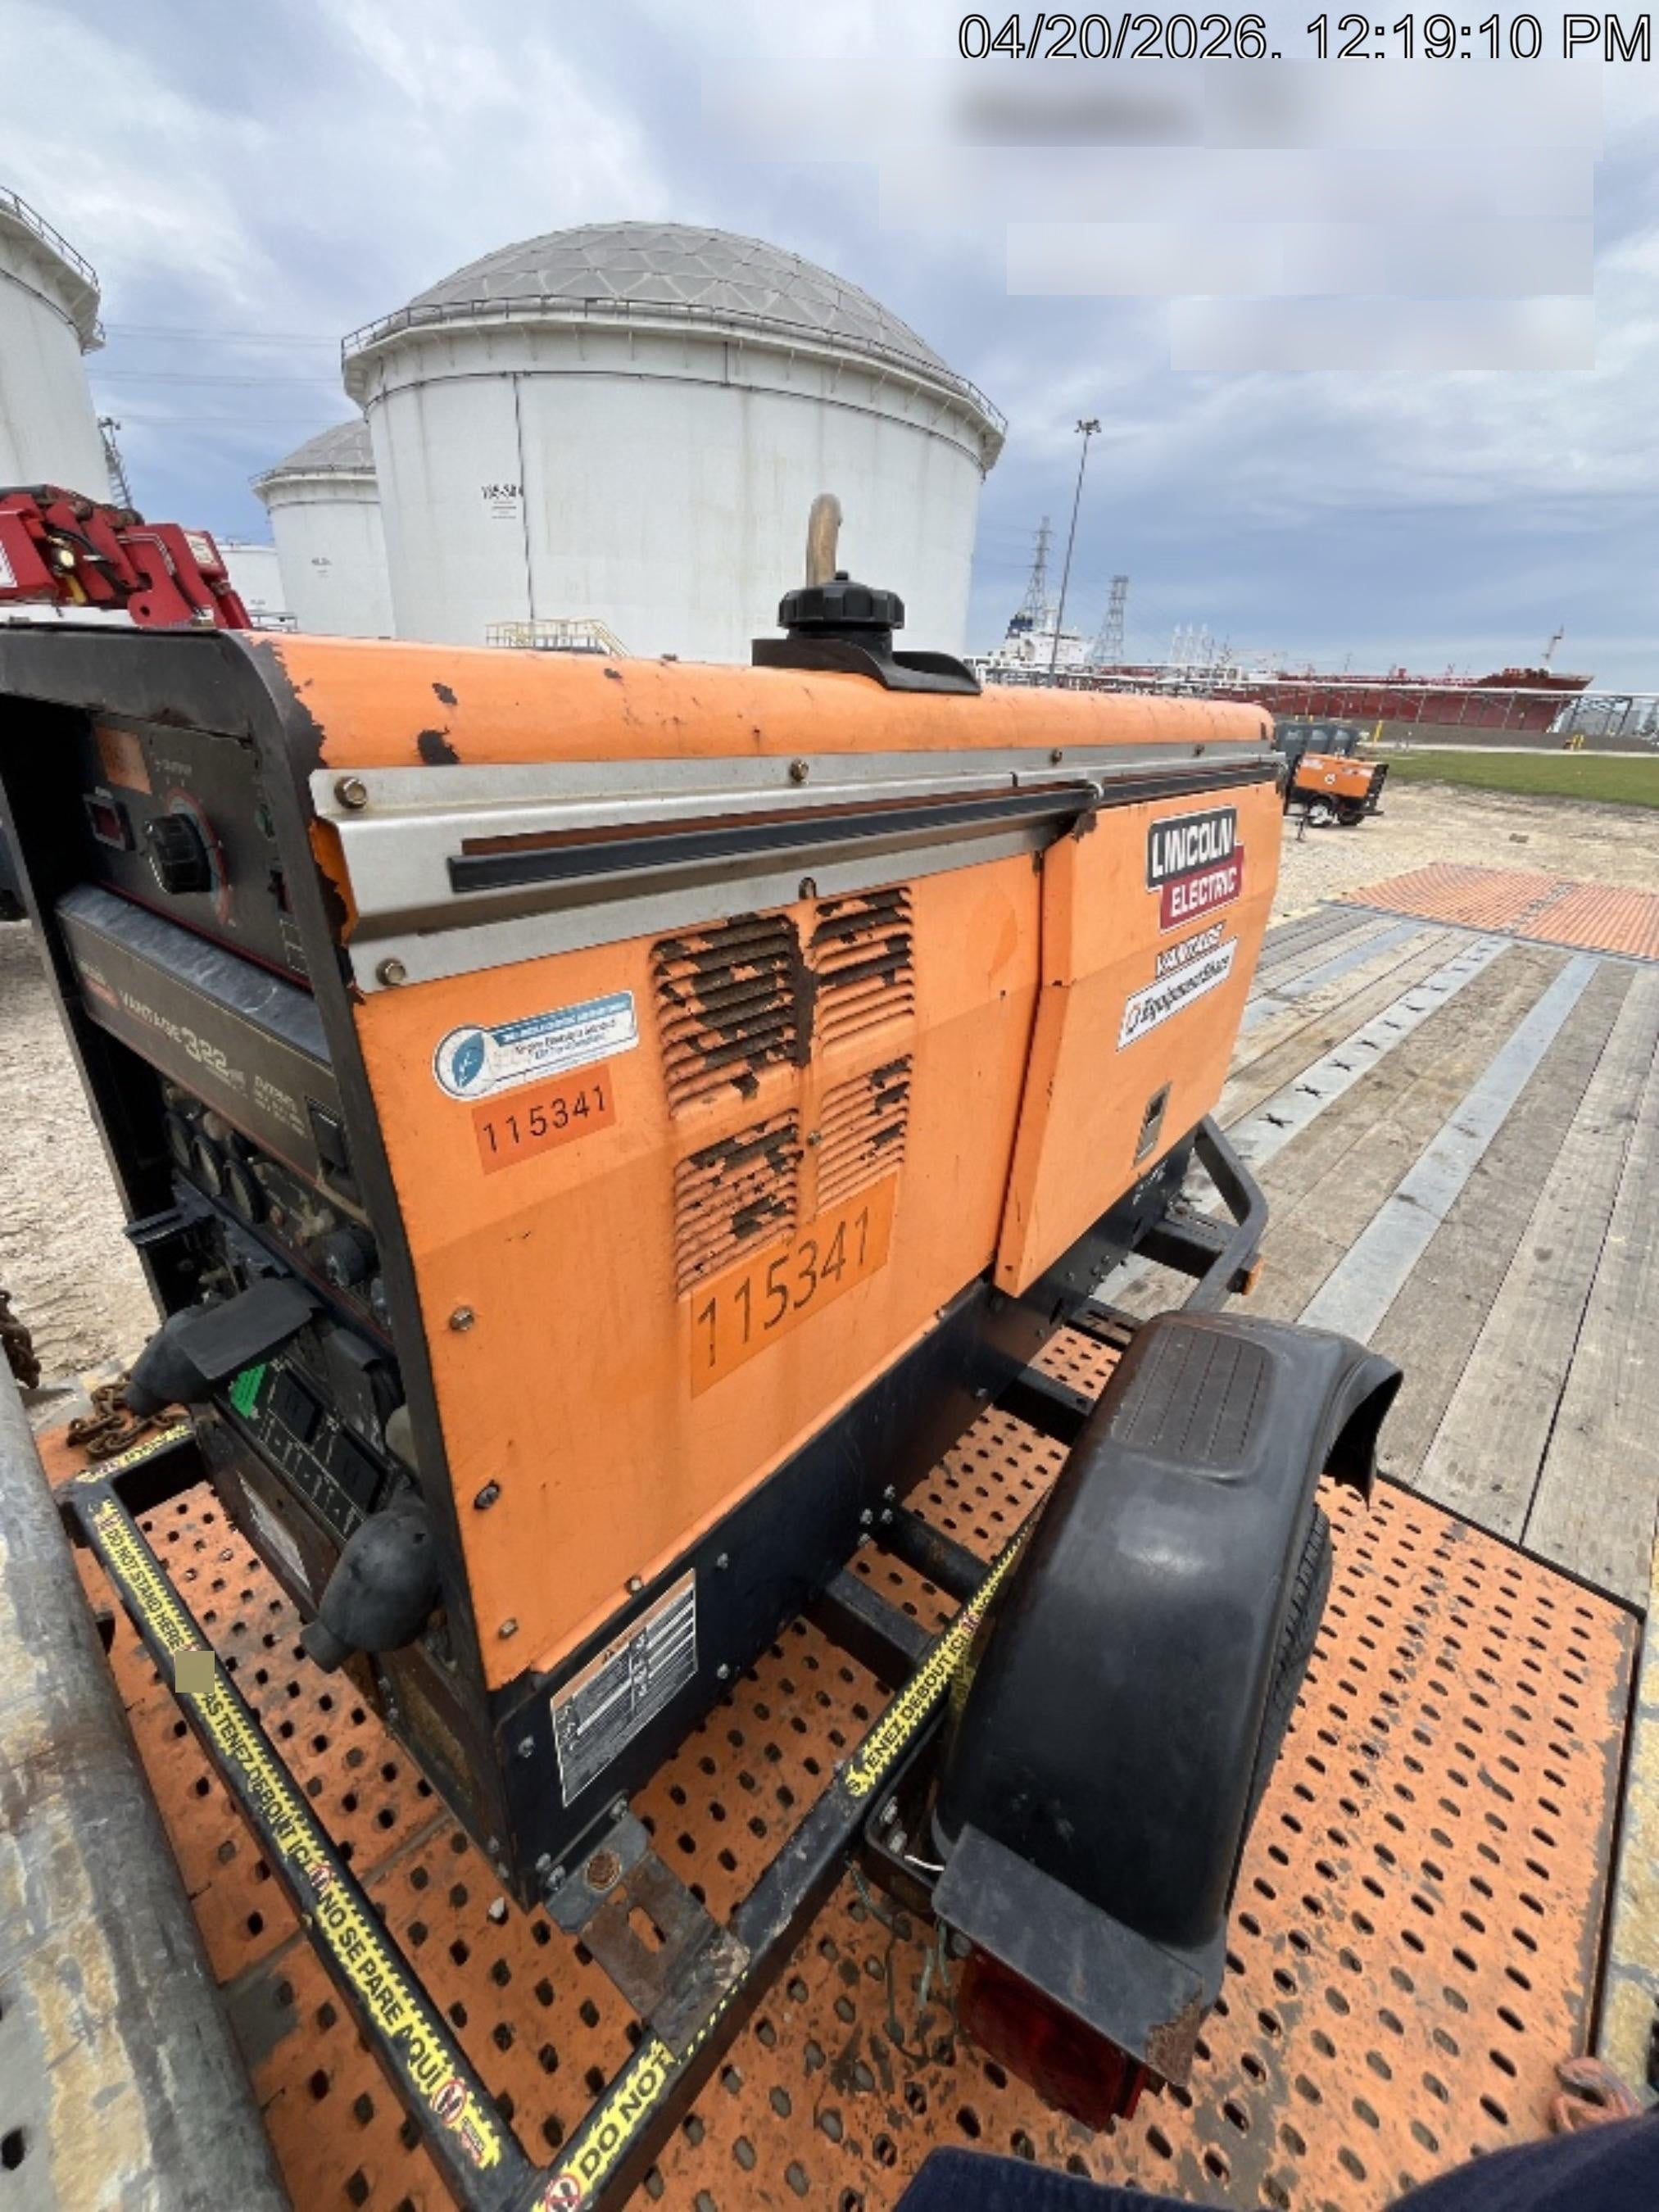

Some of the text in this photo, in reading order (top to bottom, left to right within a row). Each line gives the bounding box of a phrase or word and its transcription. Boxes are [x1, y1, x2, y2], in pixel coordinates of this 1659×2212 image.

[1151, 817, 1233, 878] LINCOLN
[1169, 867, 1237, 918] ELECTRIC
[180, 1026, 232, 1078] 322
[483, 1085, 605, 1154] 115341
[697, 1206, 869, 1368] 115341
[156, 1614, 184, 1649] HERE
[203, 1692, 224, 1716] AS
[900, 1657, 952, 1720] DEBOUT
[320, 1888, 347, 1928] NO
[338, 1925, 367, 1961] SE
[357, 1958, 405, 2026] PARE
[579, 2048, 677, 2180] DO NOT
